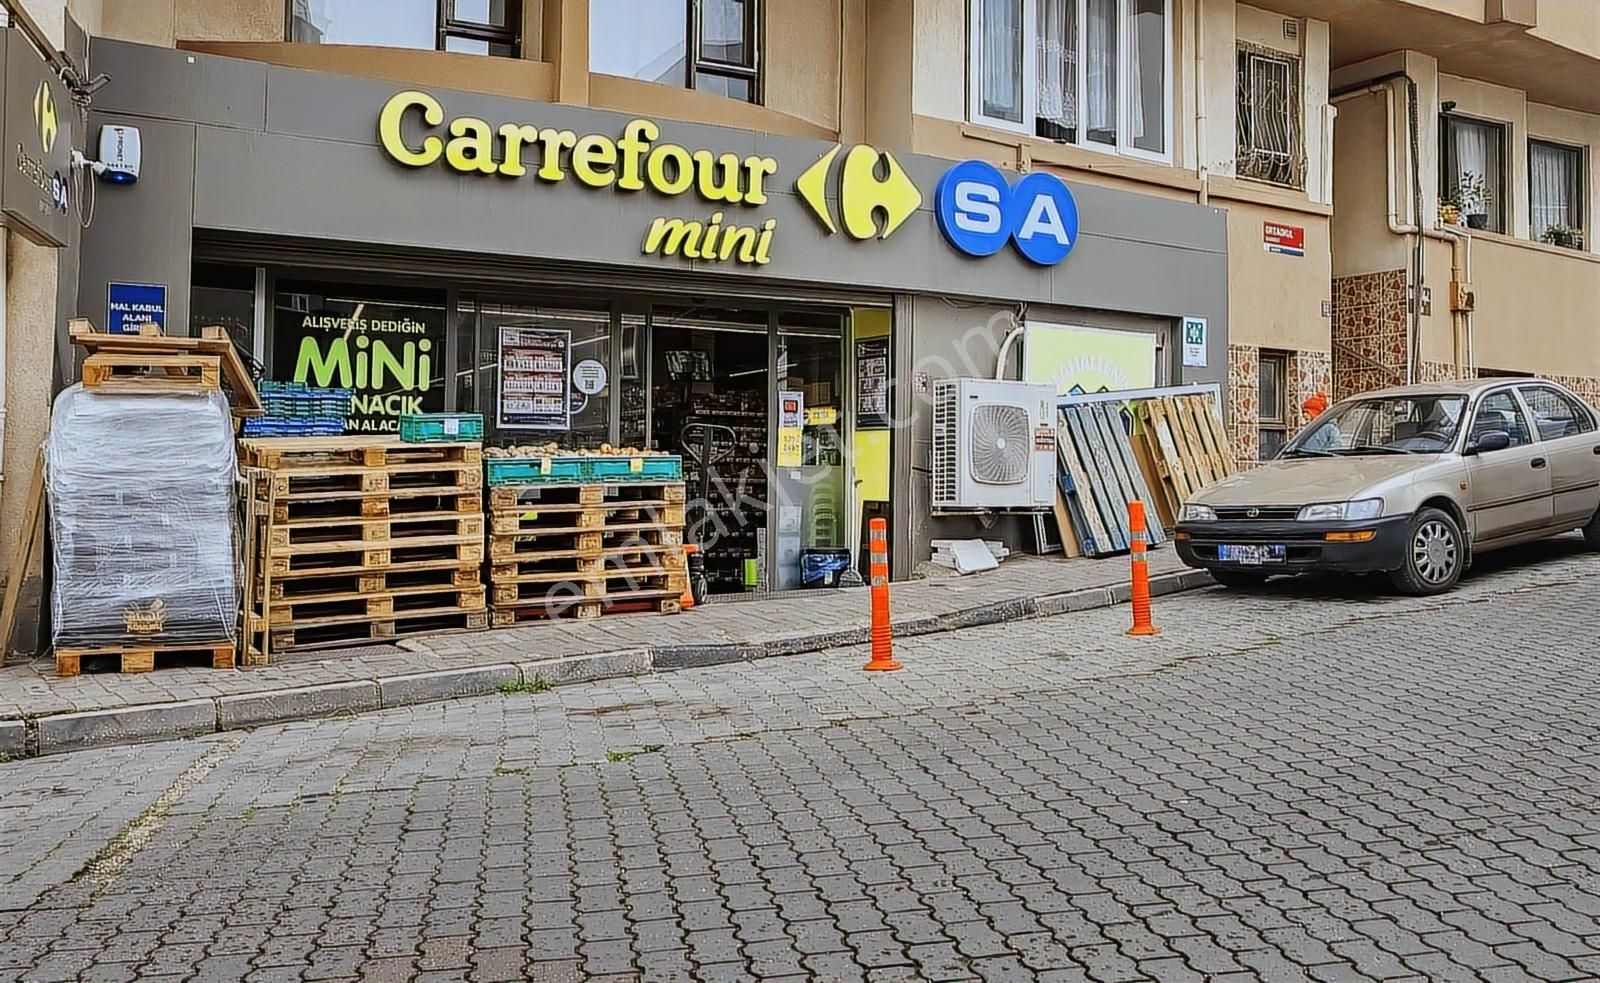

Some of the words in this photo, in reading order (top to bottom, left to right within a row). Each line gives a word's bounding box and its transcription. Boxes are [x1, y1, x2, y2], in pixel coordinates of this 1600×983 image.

[379, 89, 778, 205] Carrefour
[954, 181, 1071, 246] SA
[644, 212, 777, 265] mini
[110, 303, 131, 311] MAL
[132, 304, 164, 313] KABUL
[122, 314, 152, 323] ALANI
[351, 394, 423, 416] NACIK
[361, 420, 400, 431] ALAC
